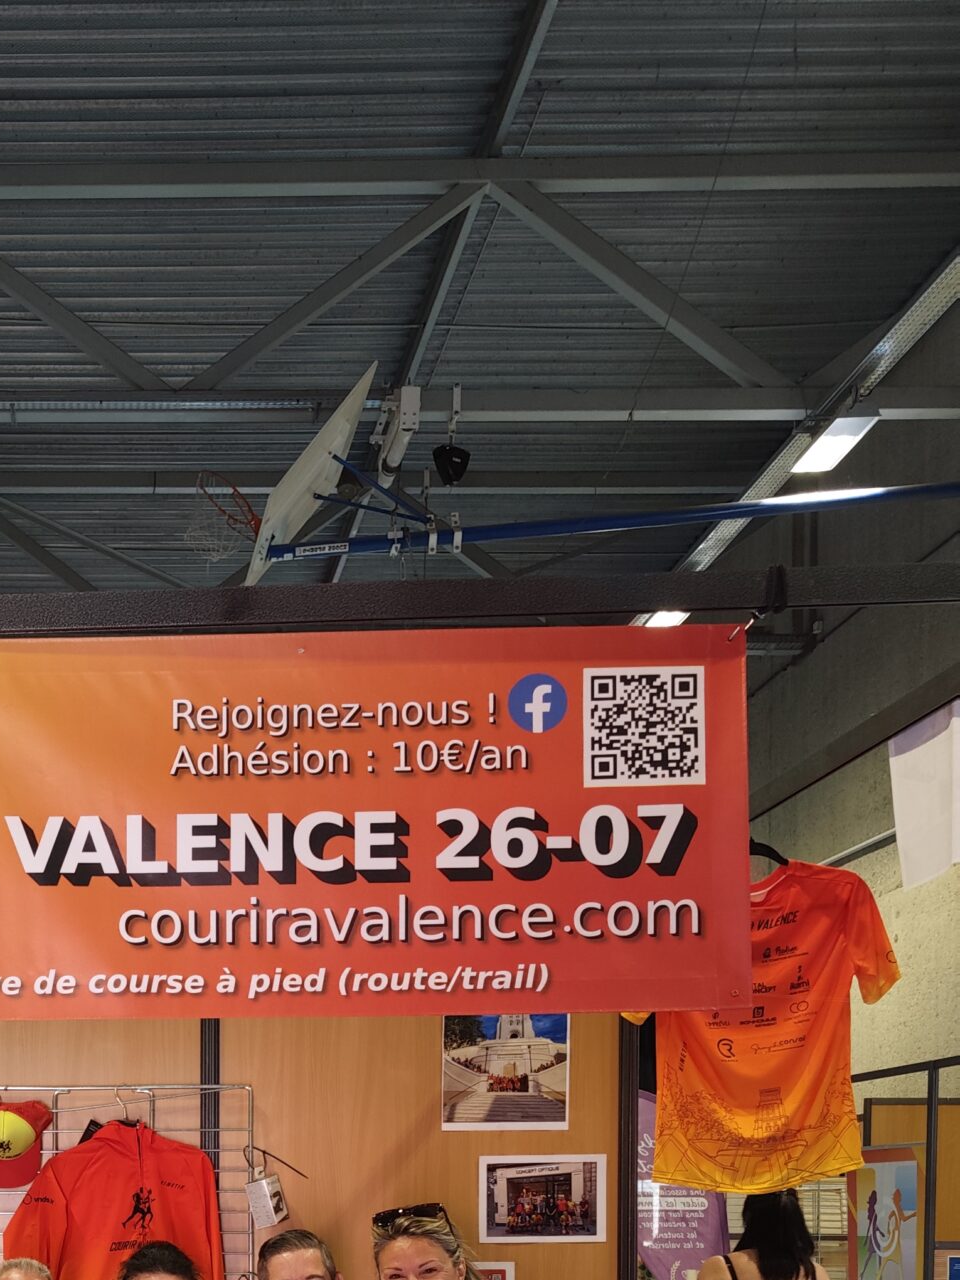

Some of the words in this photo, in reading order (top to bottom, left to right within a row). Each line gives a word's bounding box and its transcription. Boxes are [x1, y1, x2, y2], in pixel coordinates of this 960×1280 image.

[171, 696, 470, 738] Rejoignez-nous
[488, 692, 497, 724] !
[169, 741, 350, 776] Adhésion
[366, 749, 376, 773] :
[391, 739, 528, 775] 10€/an
[6, 809, 414, 887] VALENCE
[436, 803, 698, 880] 26-07
[118, 895, 702, 945] couriravalence.com
[757, 911, 800, 931] VALENCE
[33, 969, 77, 996] de
[87, 970, 205, 995] course
[216, 967, 237, 995] à
[247, 967, 326, 999] pied
[338, 963, 549, 997] (route/trail)
